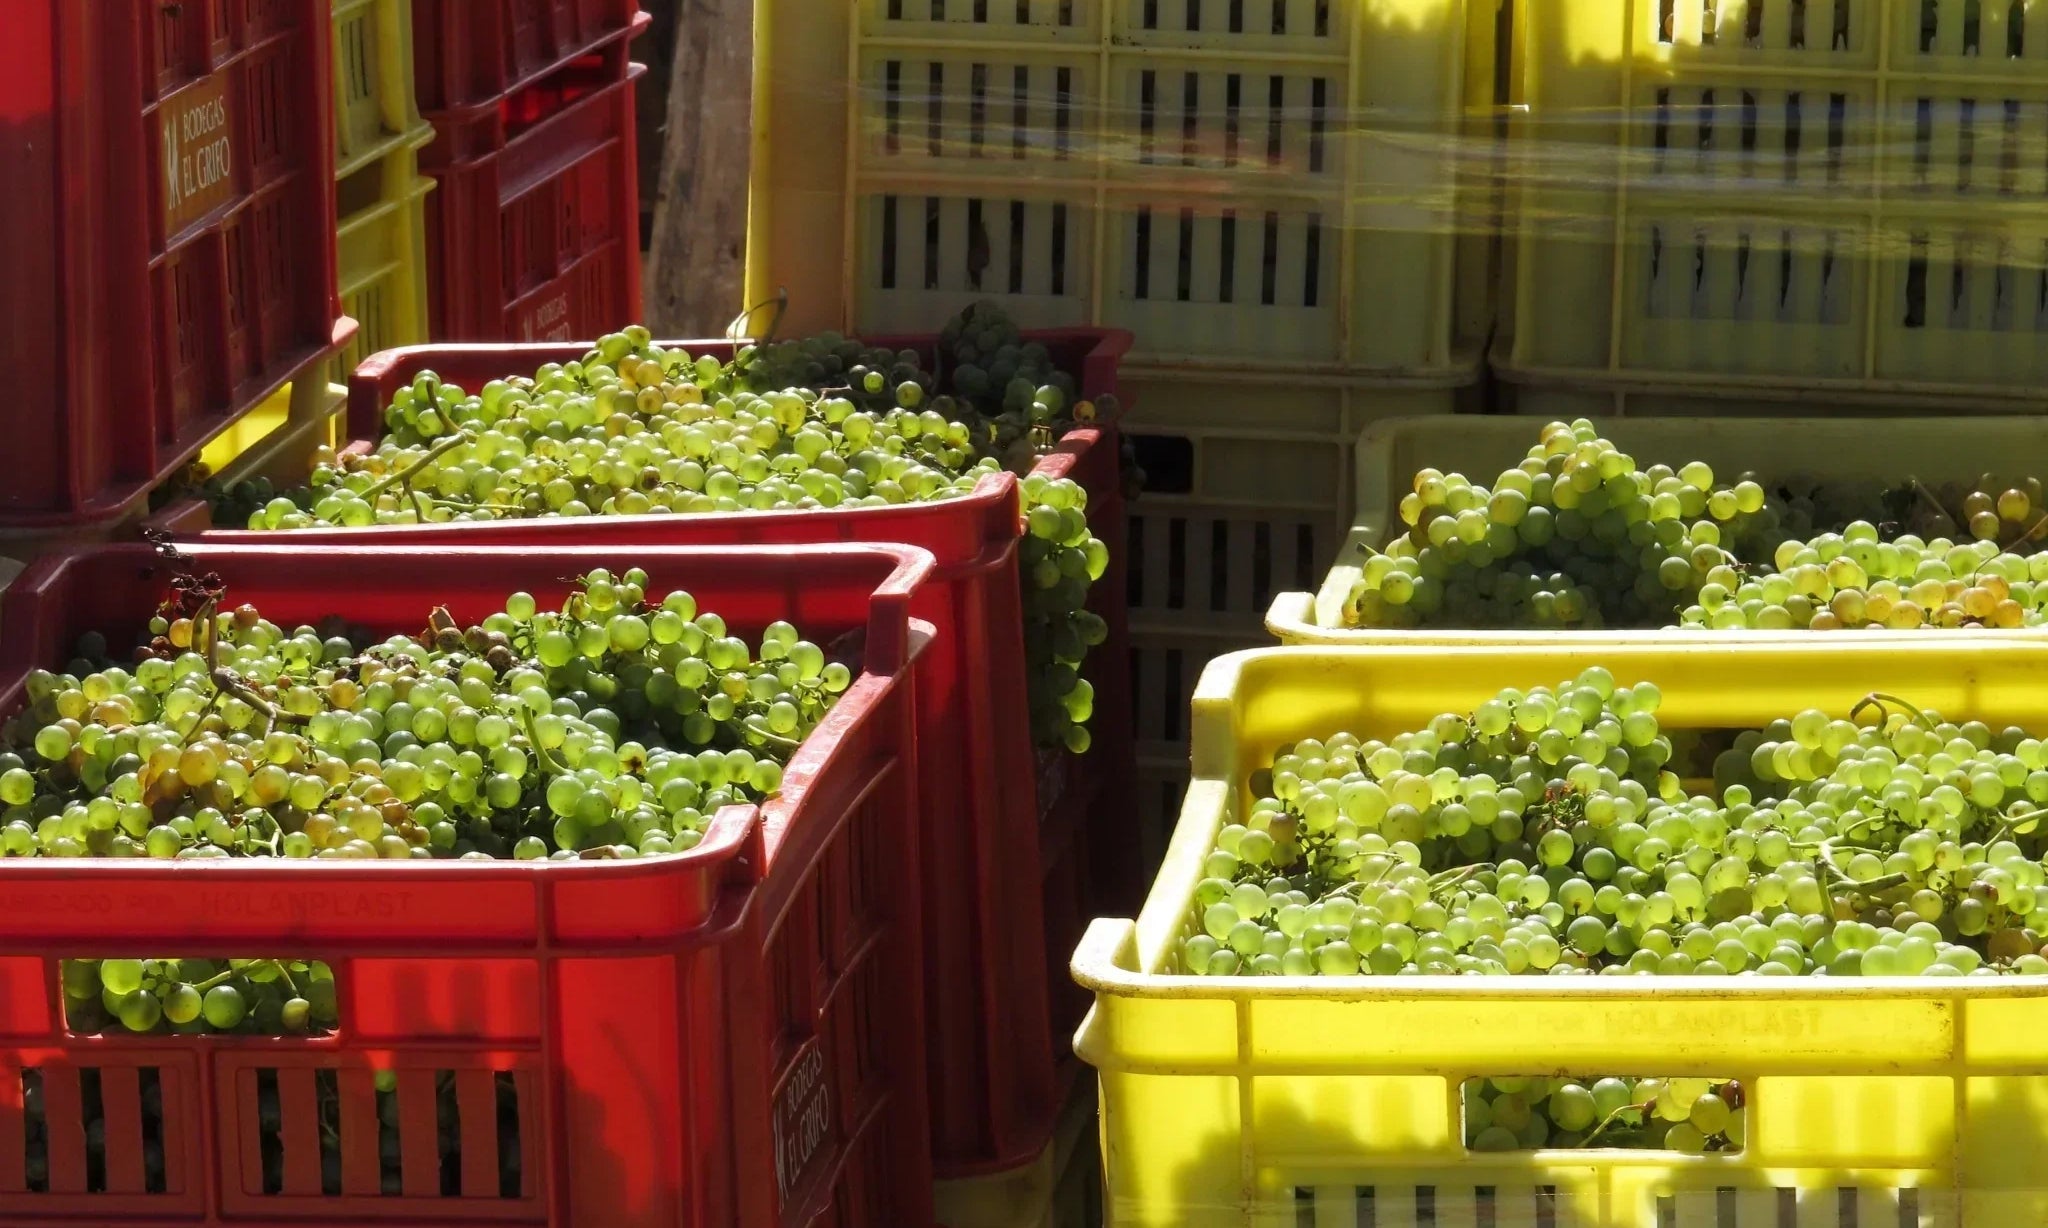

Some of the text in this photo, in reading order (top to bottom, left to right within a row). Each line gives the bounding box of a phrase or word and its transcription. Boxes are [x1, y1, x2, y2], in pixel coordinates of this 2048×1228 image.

[183, 95, 225, 143] BODEGAS
[183, 136, 231, 197] EL GRIFO
[200, 889, 415, 918] HOLANPLAST
[786, 1043, 823, 1121] BODEGAS
[788, 1083, 829, 1187] EL GRIFO
